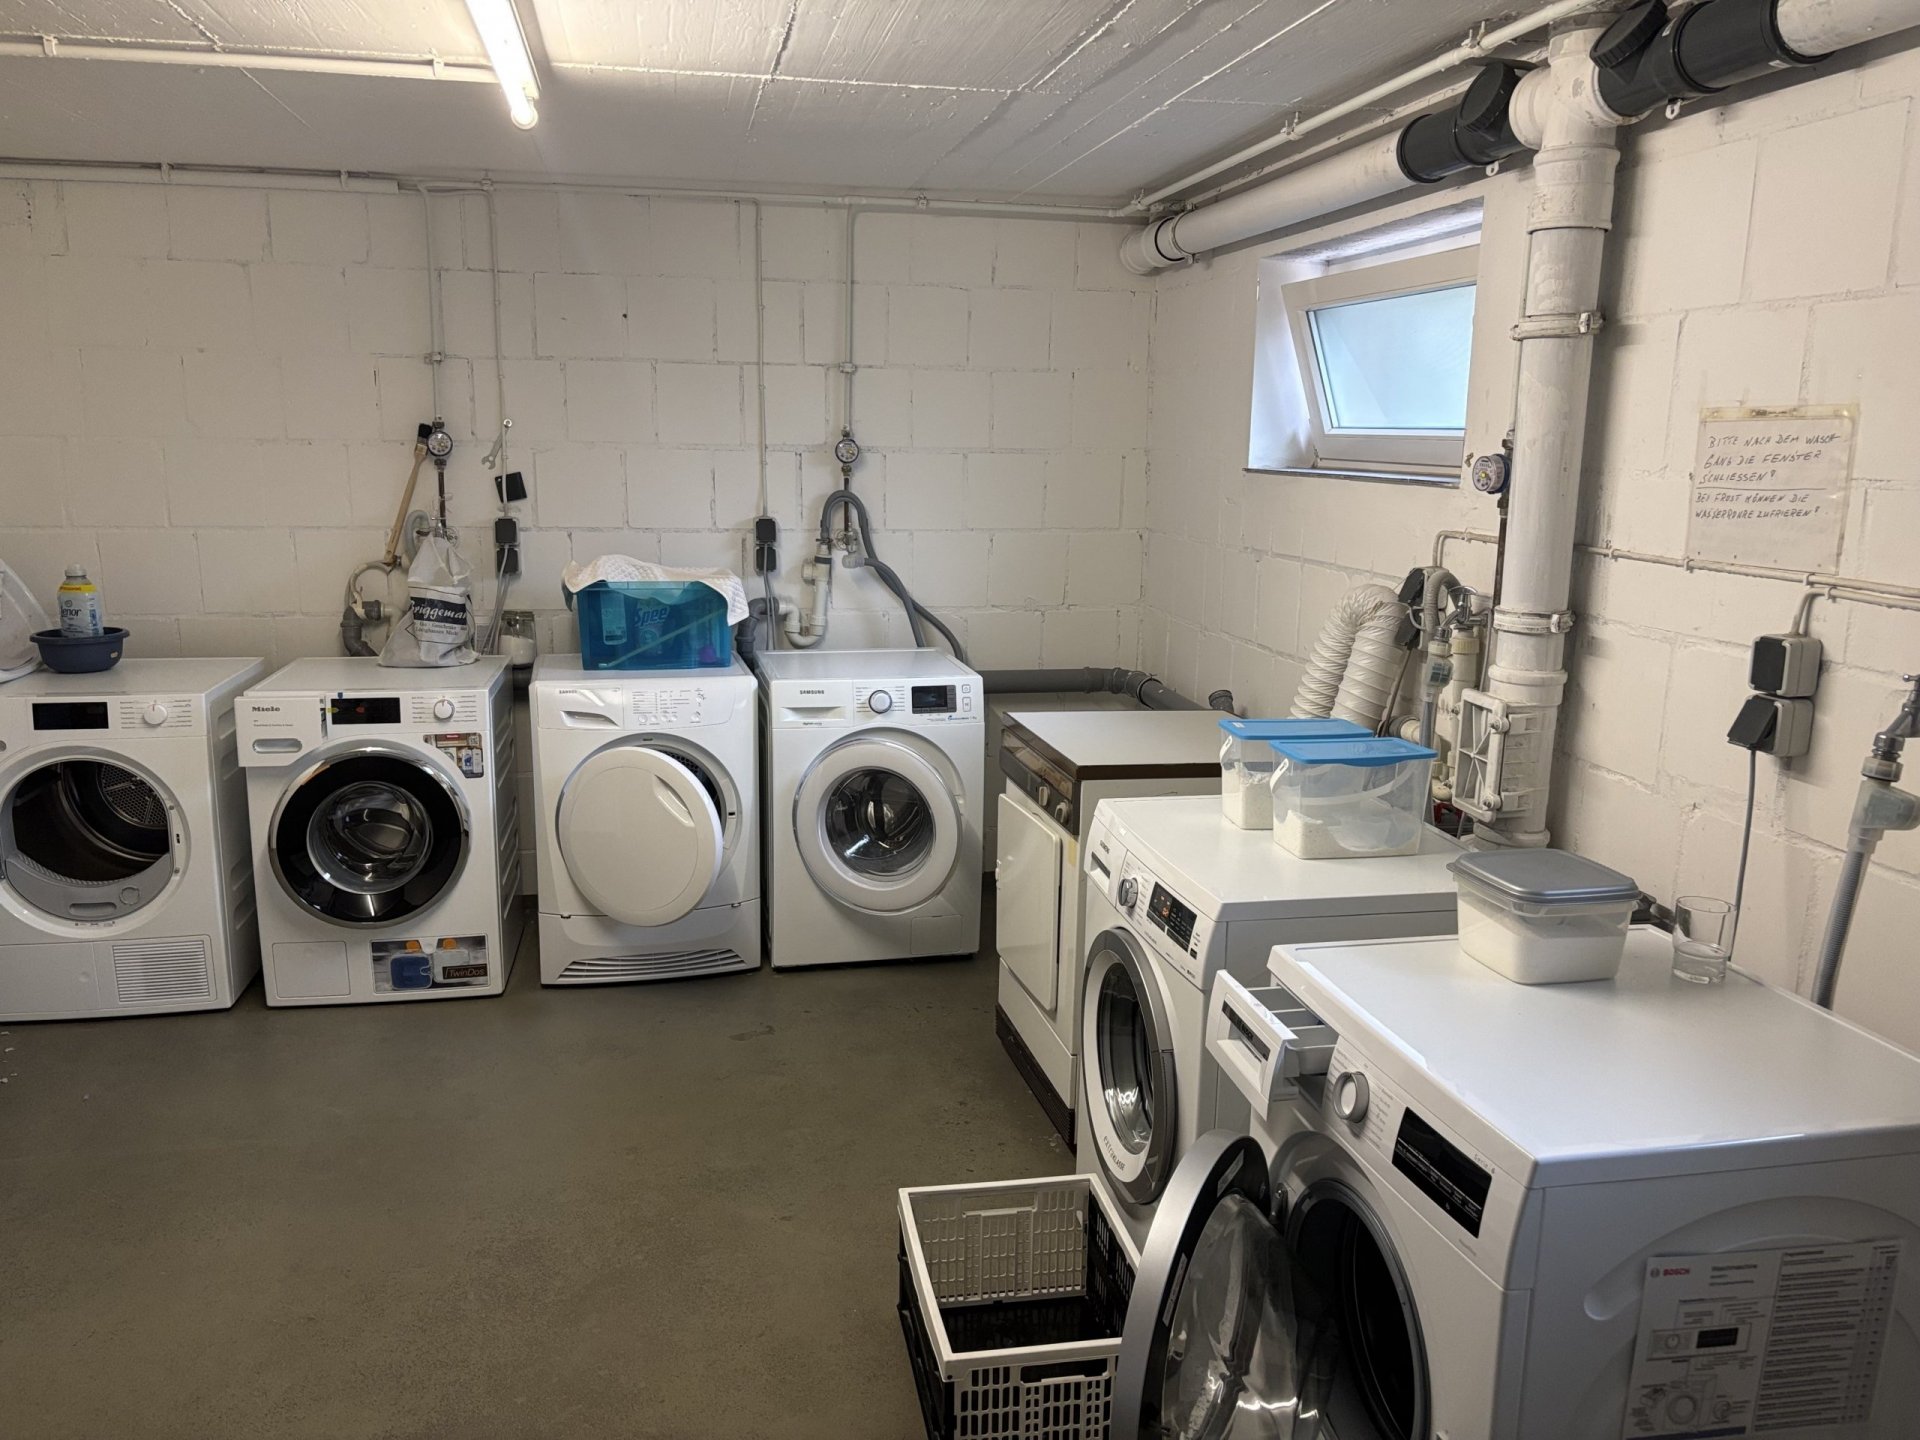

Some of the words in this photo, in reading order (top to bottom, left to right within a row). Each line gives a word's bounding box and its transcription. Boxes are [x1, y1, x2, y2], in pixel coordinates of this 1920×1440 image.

[1708, 435, 1739, 448] BITTE
[1743, 436, 1772, 447] NACH
[1775, 434, 1799, 444] DEM
[1737, 455, 1756, 466] DIE
[1762, 450, 1822, 463] FENSTER
[1714, 493, 1742, 502] FROST
[1790, 494, 1810, 503] DIE
[252, 705, 281, 713] Miele
[1662, 1267, 1691, 1277] BOSCH
